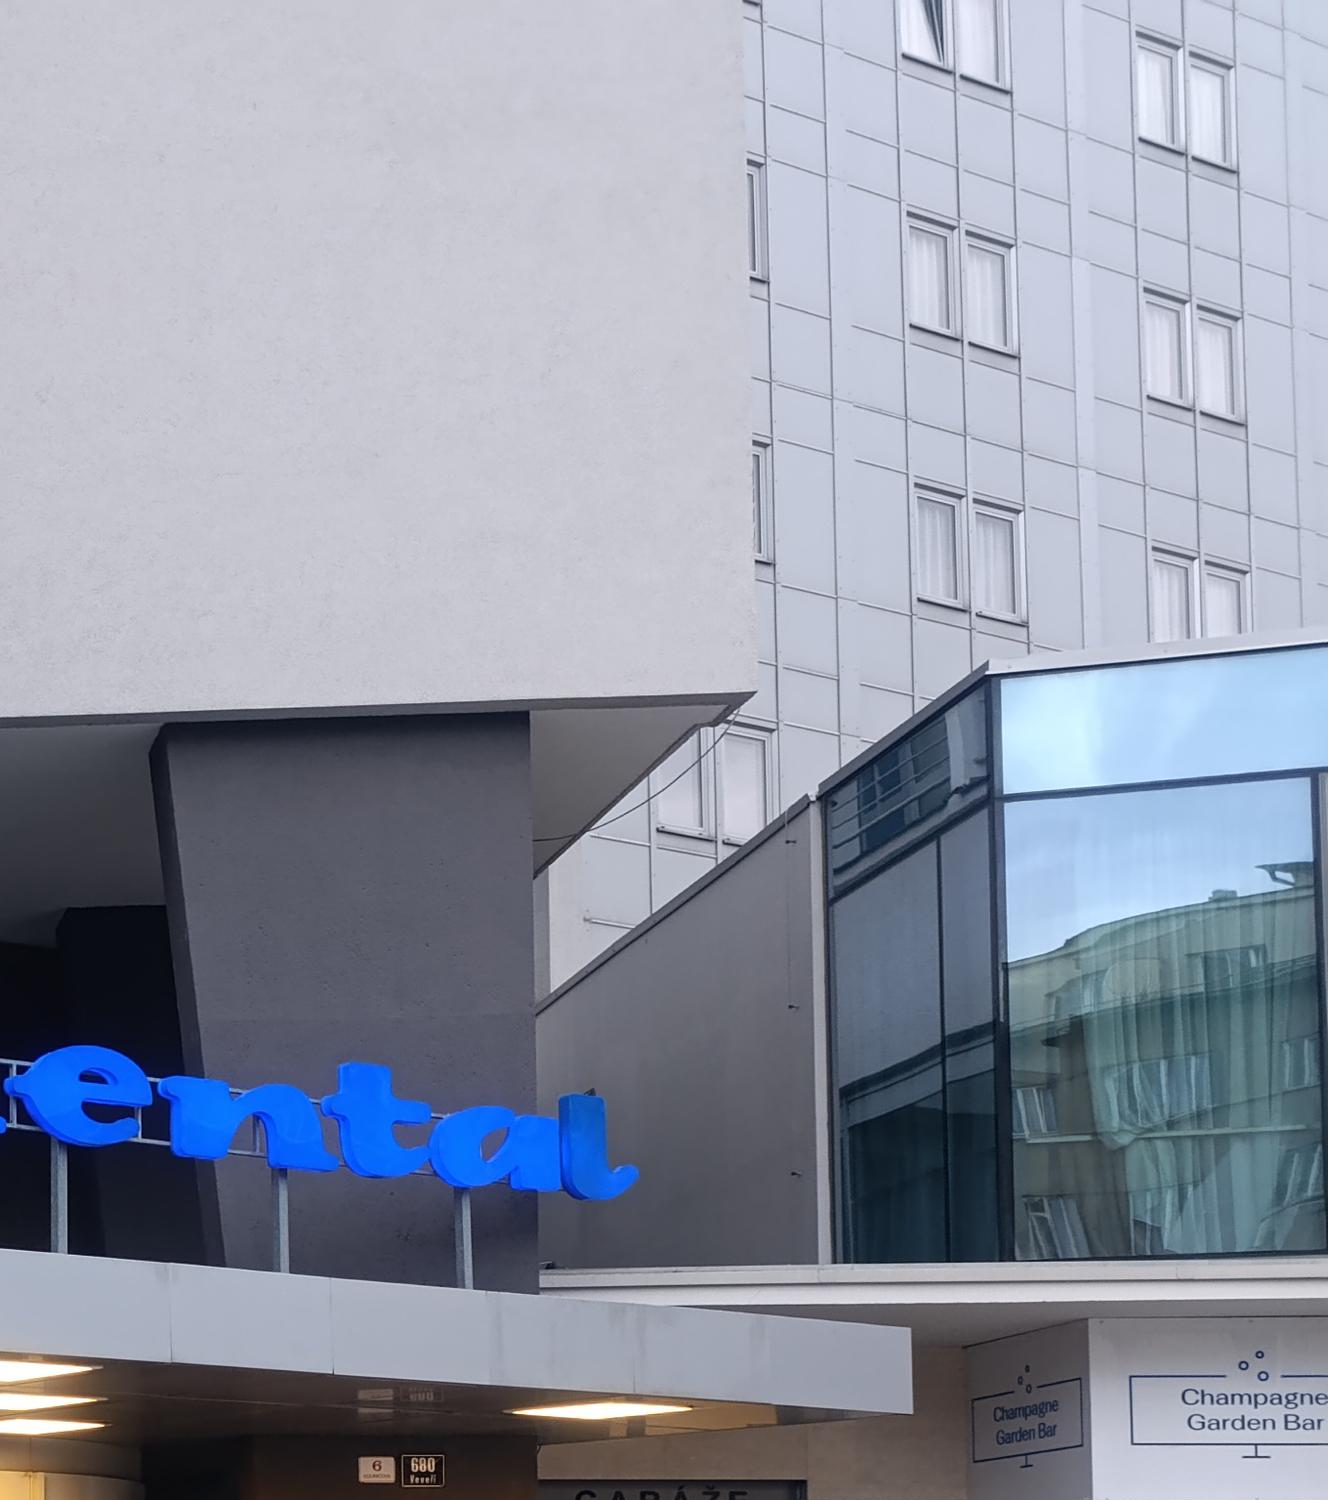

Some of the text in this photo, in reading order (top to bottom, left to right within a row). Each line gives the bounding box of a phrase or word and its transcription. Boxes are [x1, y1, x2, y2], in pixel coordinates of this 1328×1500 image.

[1180, 1388, 1328, 1409] Champagne
[994, 1399, 1058, 1423] Champagne
[1187, 1413, 1324, 1432] Garden Bar
[996, 1422, 1057, 1446] Garden Bar
[372, 1460, 382, 1471] 6
[410, 1457, 436, 1473] 680
